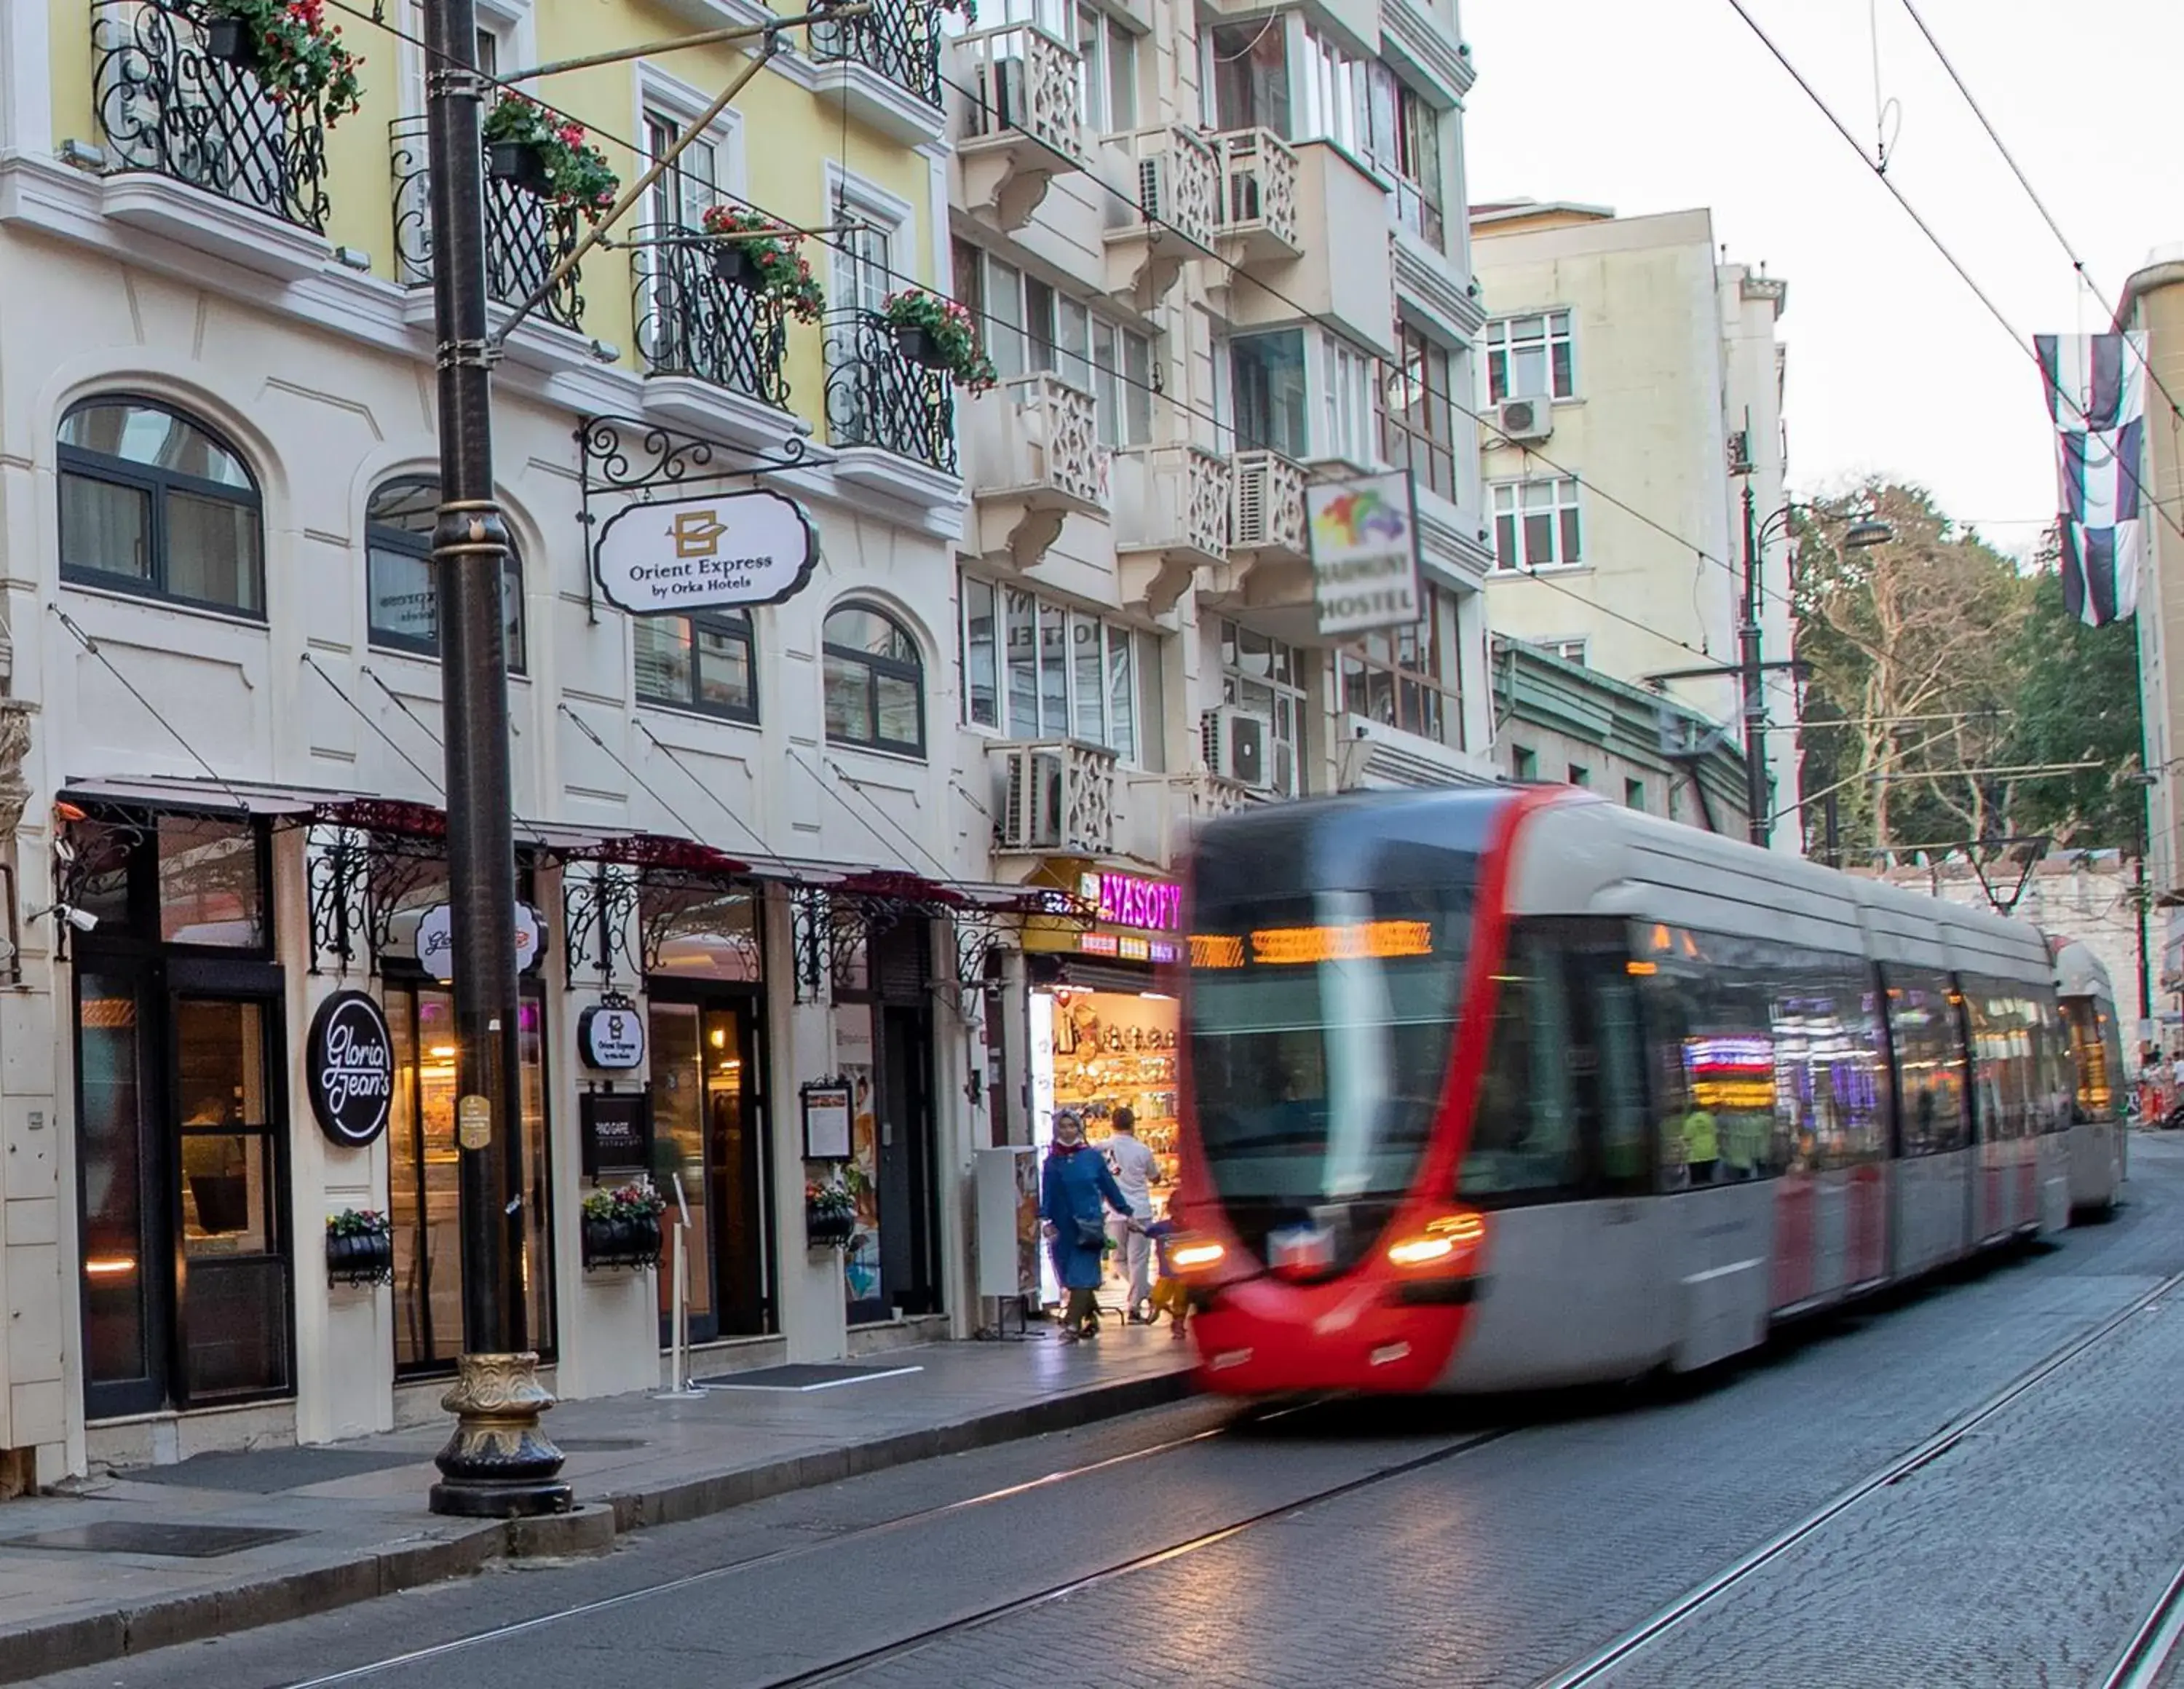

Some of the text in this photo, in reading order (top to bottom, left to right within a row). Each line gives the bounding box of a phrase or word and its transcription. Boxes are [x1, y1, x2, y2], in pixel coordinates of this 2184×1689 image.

[630, 556, 772, 581] Orient Express
[652, 577, 751, 599] by Orka Hotels
[1315, 590, 1412, 618] HOSTEL
[322, 1025, 384, 1089] Gloria
[329, 1073, 390, 1115] Jean's
